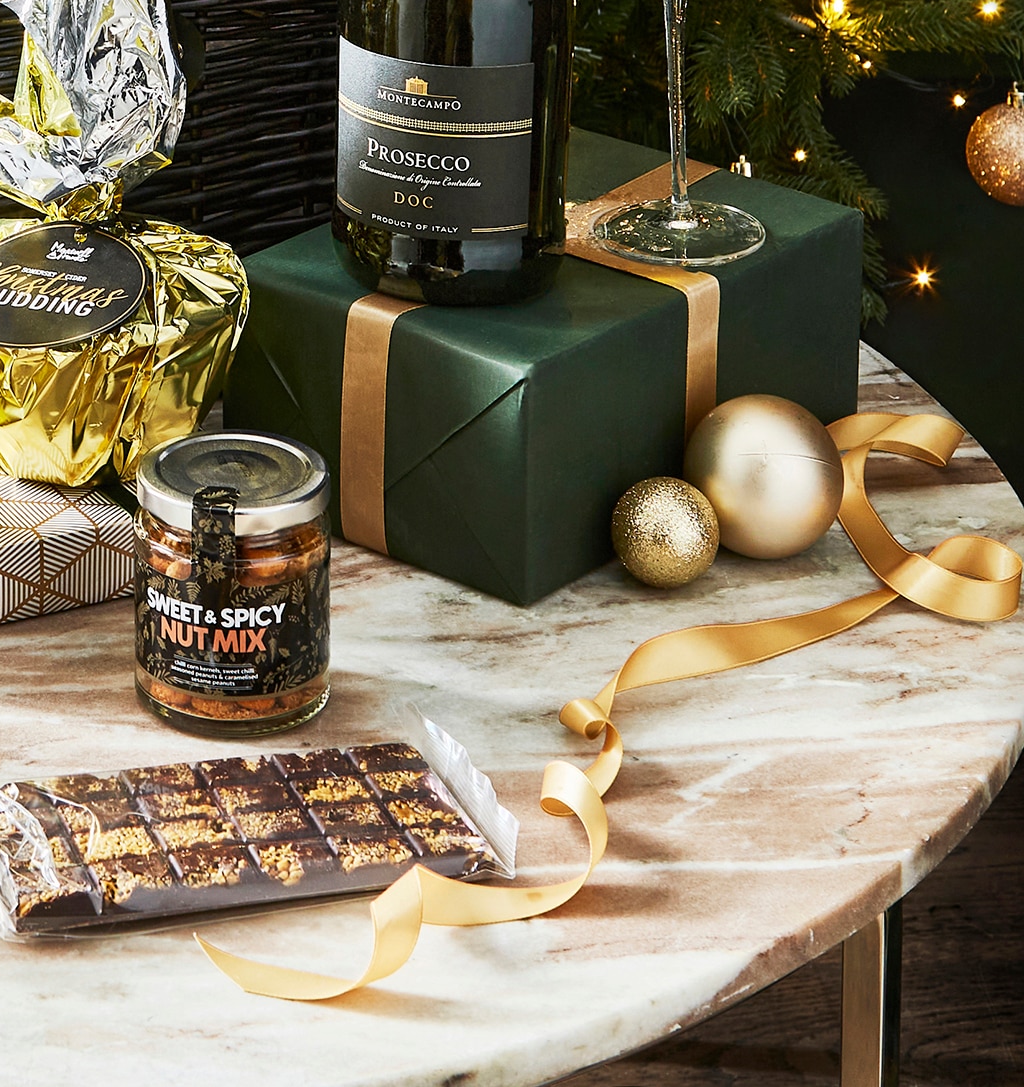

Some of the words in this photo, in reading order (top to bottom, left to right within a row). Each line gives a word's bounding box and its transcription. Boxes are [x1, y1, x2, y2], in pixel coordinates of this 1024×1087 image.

[367, 137, 470, 172] PROSECCO
[406, 172, 415, 182] di
[414, 174, 441, 191] Origine
[442, 175, 482, 187] Controllata
[393, 191, 434, 209] DOC
[371, 213, 412, 228] PRODUCT
[415, 223, 428, 231] OF
[431, 224, 459, 233] ITALY
[147, 586, 203, 625] SWEET
[205, 609, 217, 625] &
[220, 602, 286, 628] SPICY
[160, 616, 208, 650] NUT
[212, 627, 268, 653] MIX
[195, 671, 218, 679] peanuts
